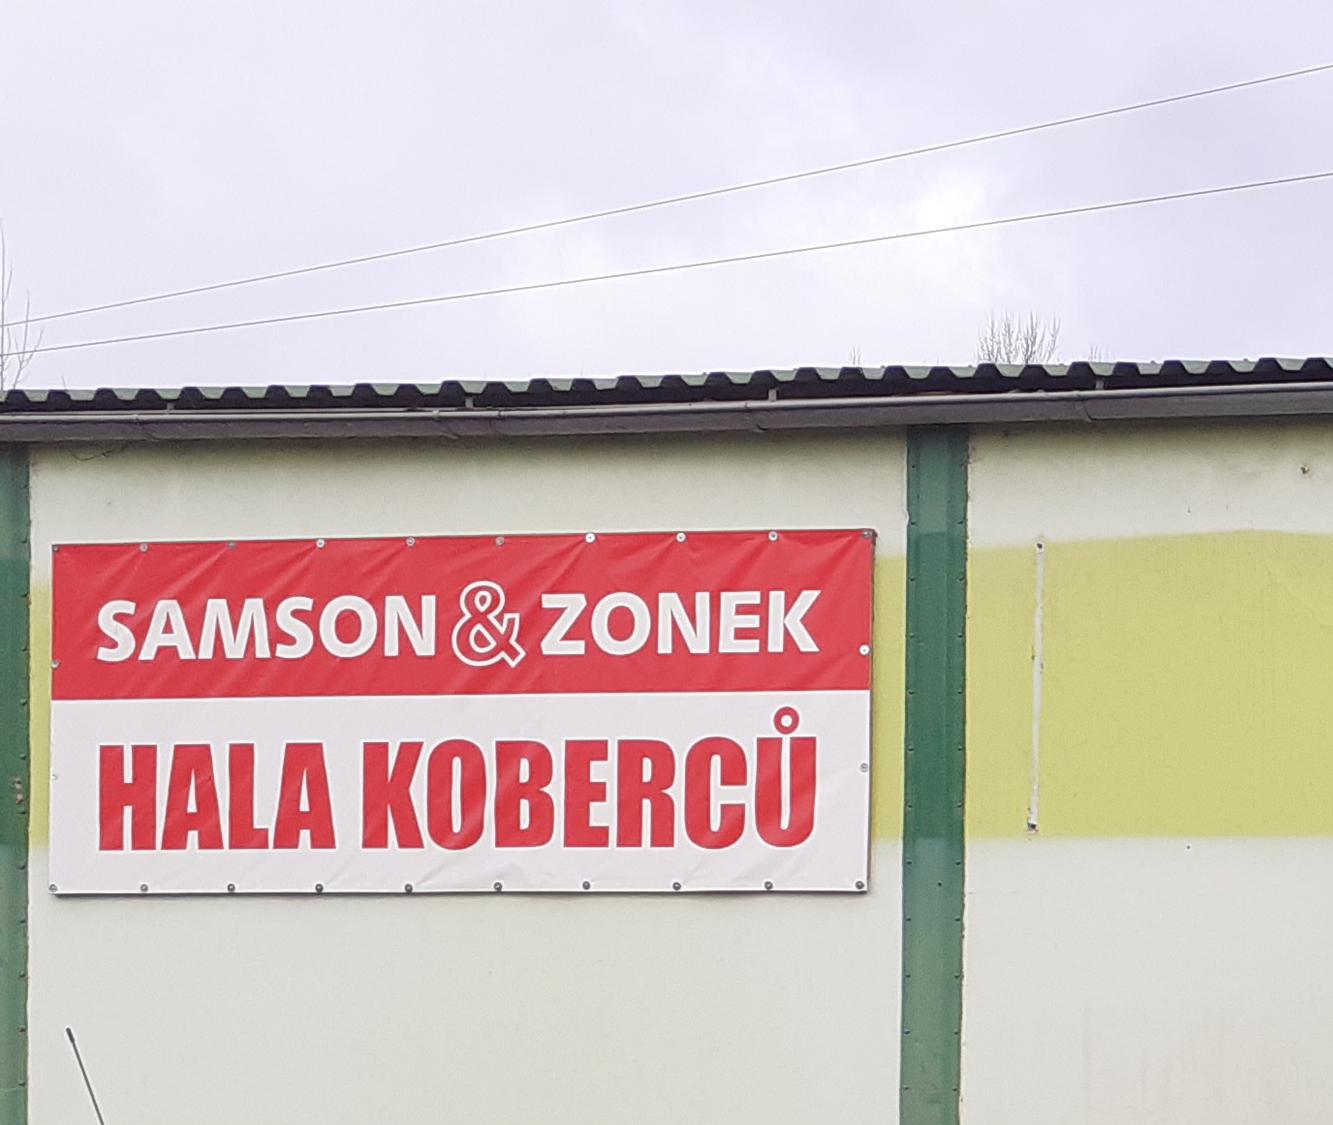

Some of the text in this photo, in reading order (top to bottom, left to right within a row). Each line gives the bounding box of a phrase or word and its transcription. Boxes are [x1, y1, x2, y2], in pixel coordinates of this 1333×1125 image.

[96, 581, 821, 668] SAMSON & ZONEK
[98, 706, 817, 851] HALA KOBERCŮ
